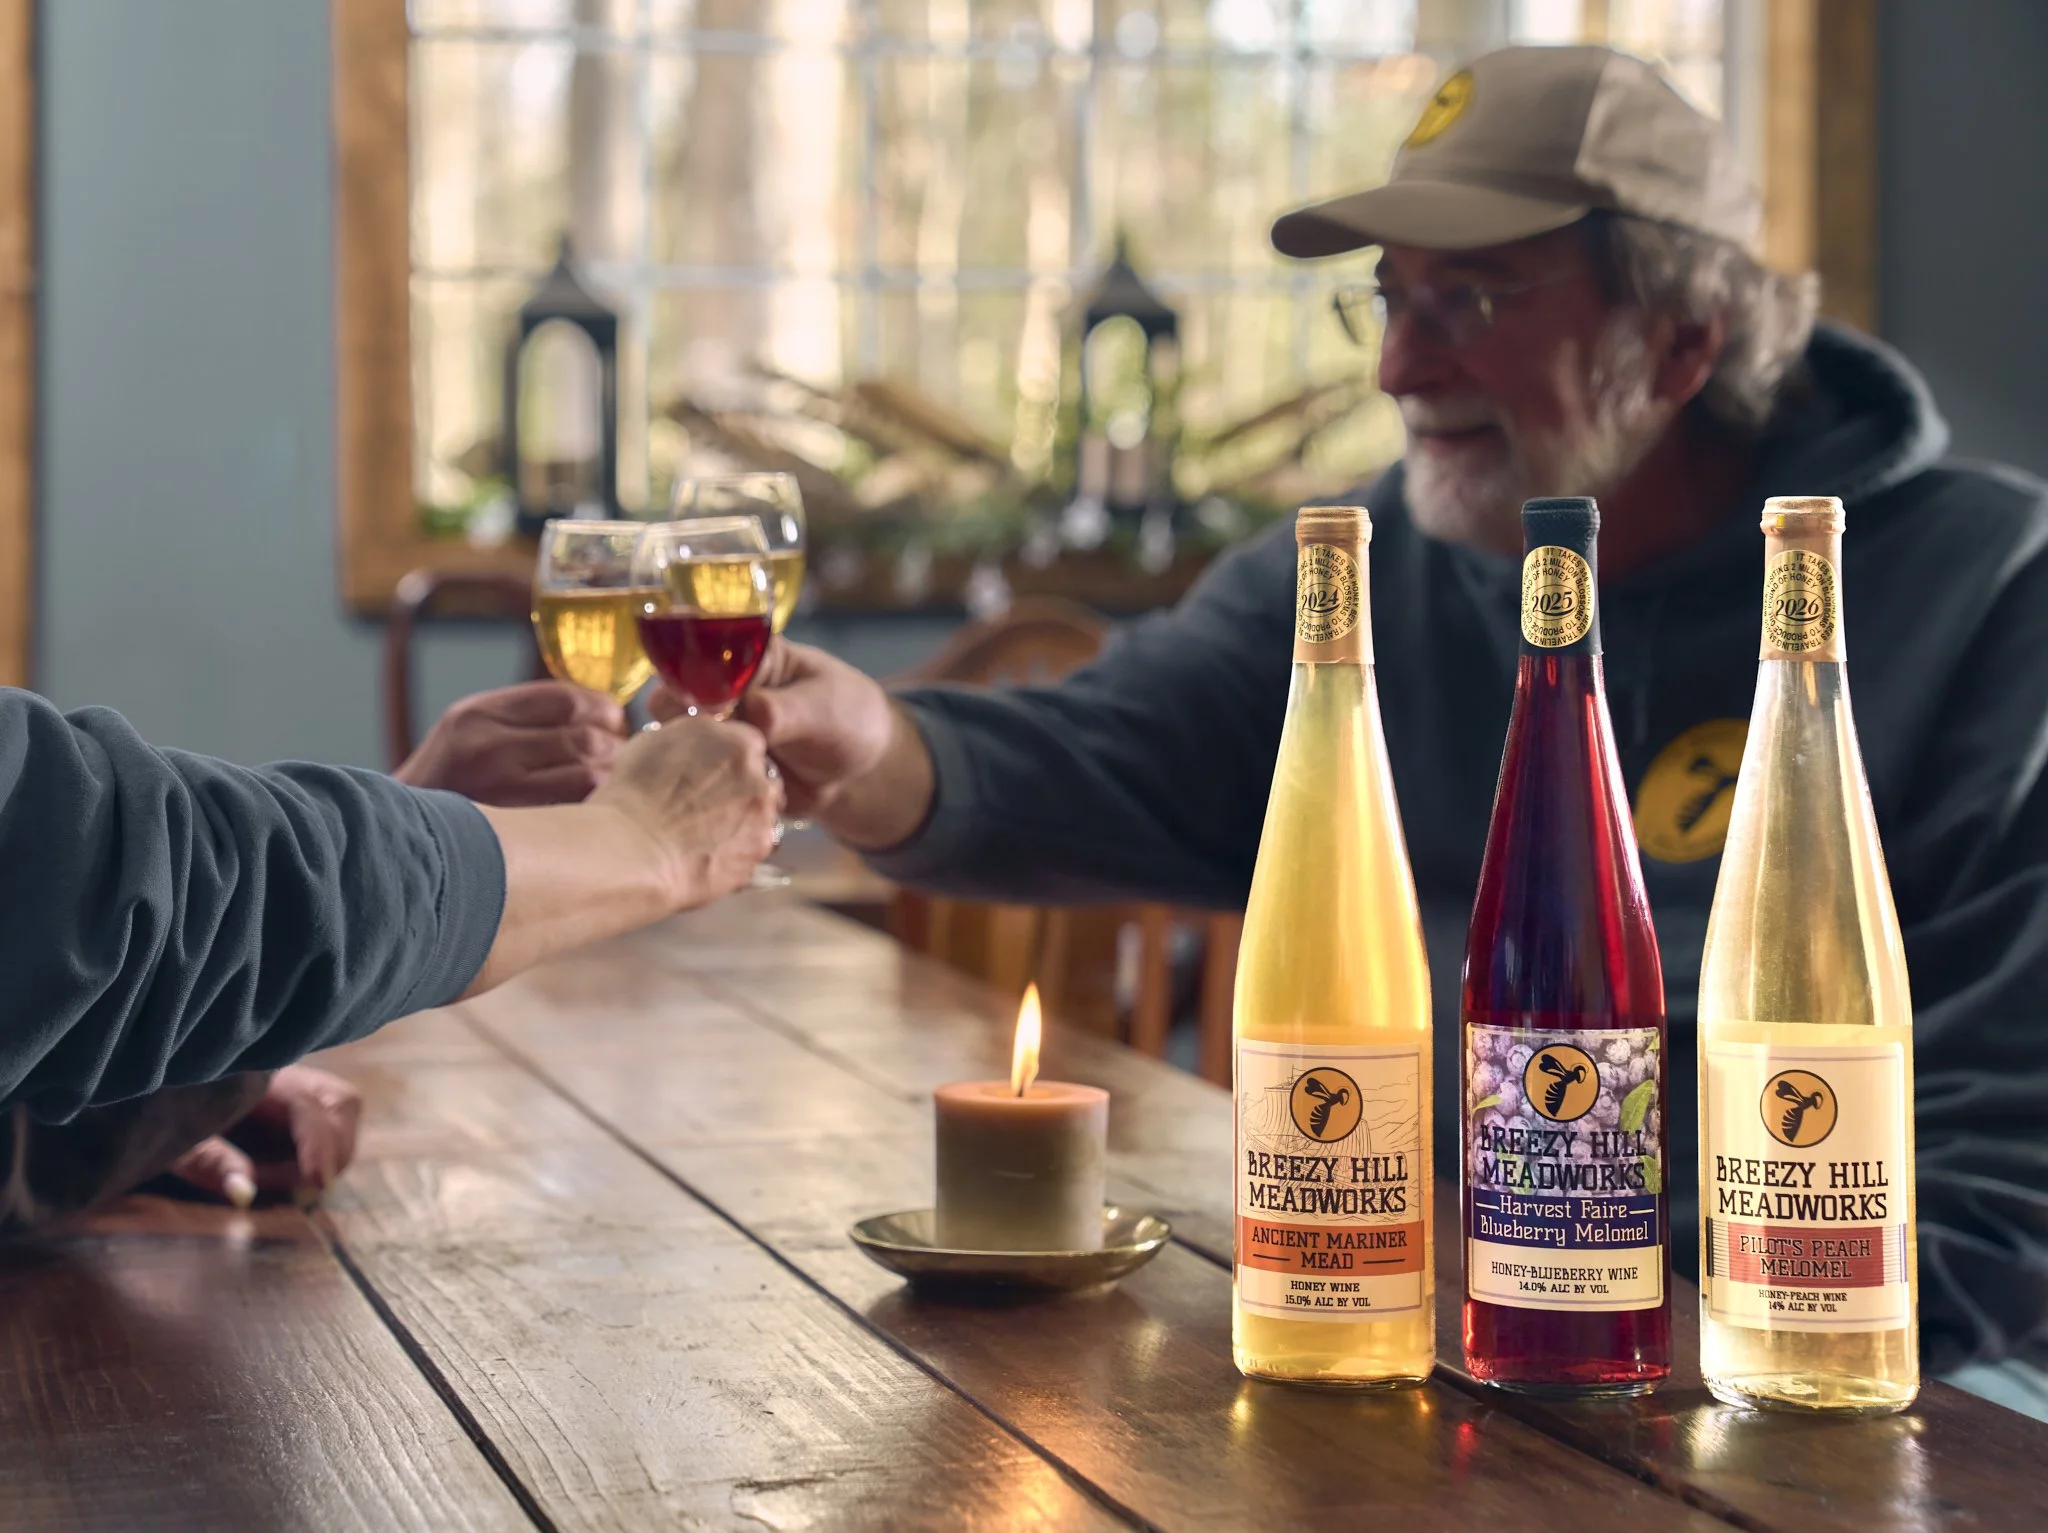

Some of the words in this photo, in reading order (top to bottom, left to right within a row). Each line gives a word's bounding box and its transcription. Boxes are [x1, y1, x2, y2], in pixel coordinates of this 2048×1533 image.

[1312, 548, 1319, 556] IT
[1322, 548, 1346, 566] TAKES
[1547, 547, 1555, 556] IT
[1558, 549, 1582, 568] TAKES
[1796, 553, 1805, 562] IT
[1315, 557, 1343, 577] MILLION
[1542, 558, 1547, 566] 2
[1549, 557, 1580, 579] MILLION
[1791, 563, 1796, 571] 2
[1808, 555, 1830, 576] TAKES
[1309, 567, 1335, 581] HONEY
[1532, 570, 1541, 581] OF
[1542, 567, 1570, 582] HONEY
[1778, 574, 1788, 585] OF
[1789, 573, 1818, 588] HONEY
[1798, 562, 1826, 586] MILLION
[1301, 588, 1339, 611] 2024
[1340, 575, 1352, 617] BLOSSOMS
[1351, 580, 1360, 608] HONEY
[1531, 592, 1572, 613] 2025
[1575, 577, 1586, 621] BLOSSOMS
[1775, 597, 1819, 616] 2026
[1819, 585, 1832, 629] BLOSSOMS
[1301, 619, 1331, 633] PRODUCE
[1331, 615, 1343, 626] TO
[1342, 608, 1358, 628] BEES
[1565, 620, 1577, 630] TO
[1303, 626, 1345, 642] TRAVELING
[1531, 621, 1565, 636] PRODUCE
[1773, 625, 1808, 641] PRODUCE
[1809, 626, 1821, 637] TO
[1533, 632, 1578, 646] TRAVELING
[1776, 637, 1822, 651] TRAVELING
[1480, 1124, 1578, 1157] BREEZY
[1590, 1129, 1647, 1158] HILL
[1247, 1149, 1339, 1183] BREEZY
[1351, 1154, 1408, 1183] HILL
[1482, 1156, 1646, 1191] MEADWORKS
[1716, 1155, 1816, 1188] BREEZY
[1828, 1160, 1889, 1189] HILL
[1249, 1181, 1407, 1215] MEADWORKS
[1500, 1195, 1572, 1219] Harvest
[1581, 1200, 1628, 1219] Faire
[1717, 1187, 1888, 1221] MEADWORKS
[1251, 1226, 1321, 1249] ANCIENT
[1326, 1230, 1408, 1249] MARINER
[1480, 1214, 1567, 1247] Blueberry
[1574, 1221, 1649, 1243] Melomel
[1739, 1234, 1803, 1257] PILOT'S
[1812, 1239, 1872, 1257] PEACH
[1301, 1251, 1354, 1270] MEAD
[1760, 1258, 1853, 1279] MELOMEL
[1491, 1261, 1604, 1281] HONEY-BLUEBERRY
[1608, 1267, 1639, 1280] WINE
[1290, 1280, 1327, 1292] HONEY
[1329, 1281, 1360, 1293] WINE
[1518, 1281, 1547, 1294] 14.0%
[1550, 1283, 1570, 1294] ALC
[1573, 1284, 1586, 1294] BY
[1589, 1284, 1610, 1294] VOL
[1758, 1288, 1820, 1302] HONEY-PEACH
[1822, 1291, 1848, 1302] WINE
[1285, 1294, 1312, 1307] 15.0%
[1314, 1296, 1334, 1307] ALC
[1336, 1297, 1350, 1307] BY
[1352, 1297, 1371, 1307] VOL
[1768, 1300, 1785, 1312] 14%
[1788, 1302, 1805, 1312] ALC
[1807, 1302, 1818, 1313] BY
[1821, 1302, 1837, 1313] VOL
